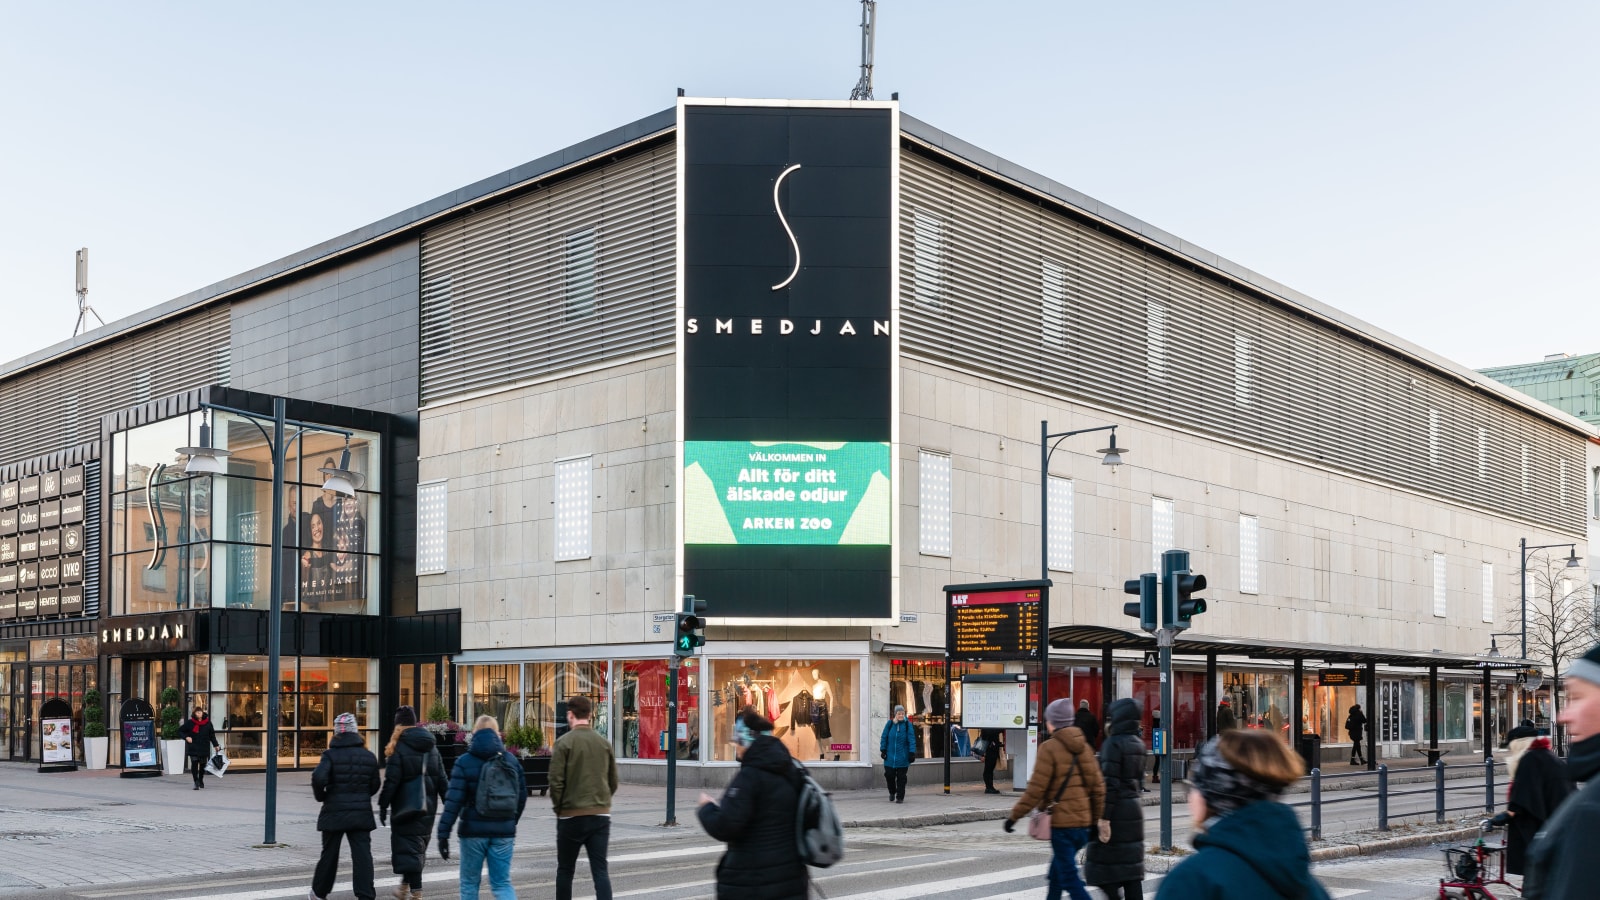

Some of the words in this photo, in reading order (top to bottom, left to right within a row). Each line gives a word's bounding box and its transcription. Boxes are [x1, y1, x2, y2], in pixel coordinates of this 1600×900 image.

[686, 318, 890, 336] SMEDJAN
[749, 451, 814, 462] VÄLKOMMEN
[815, 453, 827, 462] IN
[738, 468, 769, 483] Allt
[773, 468, 800, 483] för
[804, 468, 837, 483] ditt
[726, 486, 795, 502] älskade
[800, 487, 848, 504] odjur
[743, 517, 795, 530] ARKEN
[800, 517, 832, 530] ZOO
[63, 562, 80, 578] LYKO
[39, 596, 58, 607] HEMTEX
[102, 624, 184, 643] SMEDJAN
[1146, 654, 1156, 666] A
[1518, 674, 1526, 682] A
[640, 697, 663, 707] SALE
